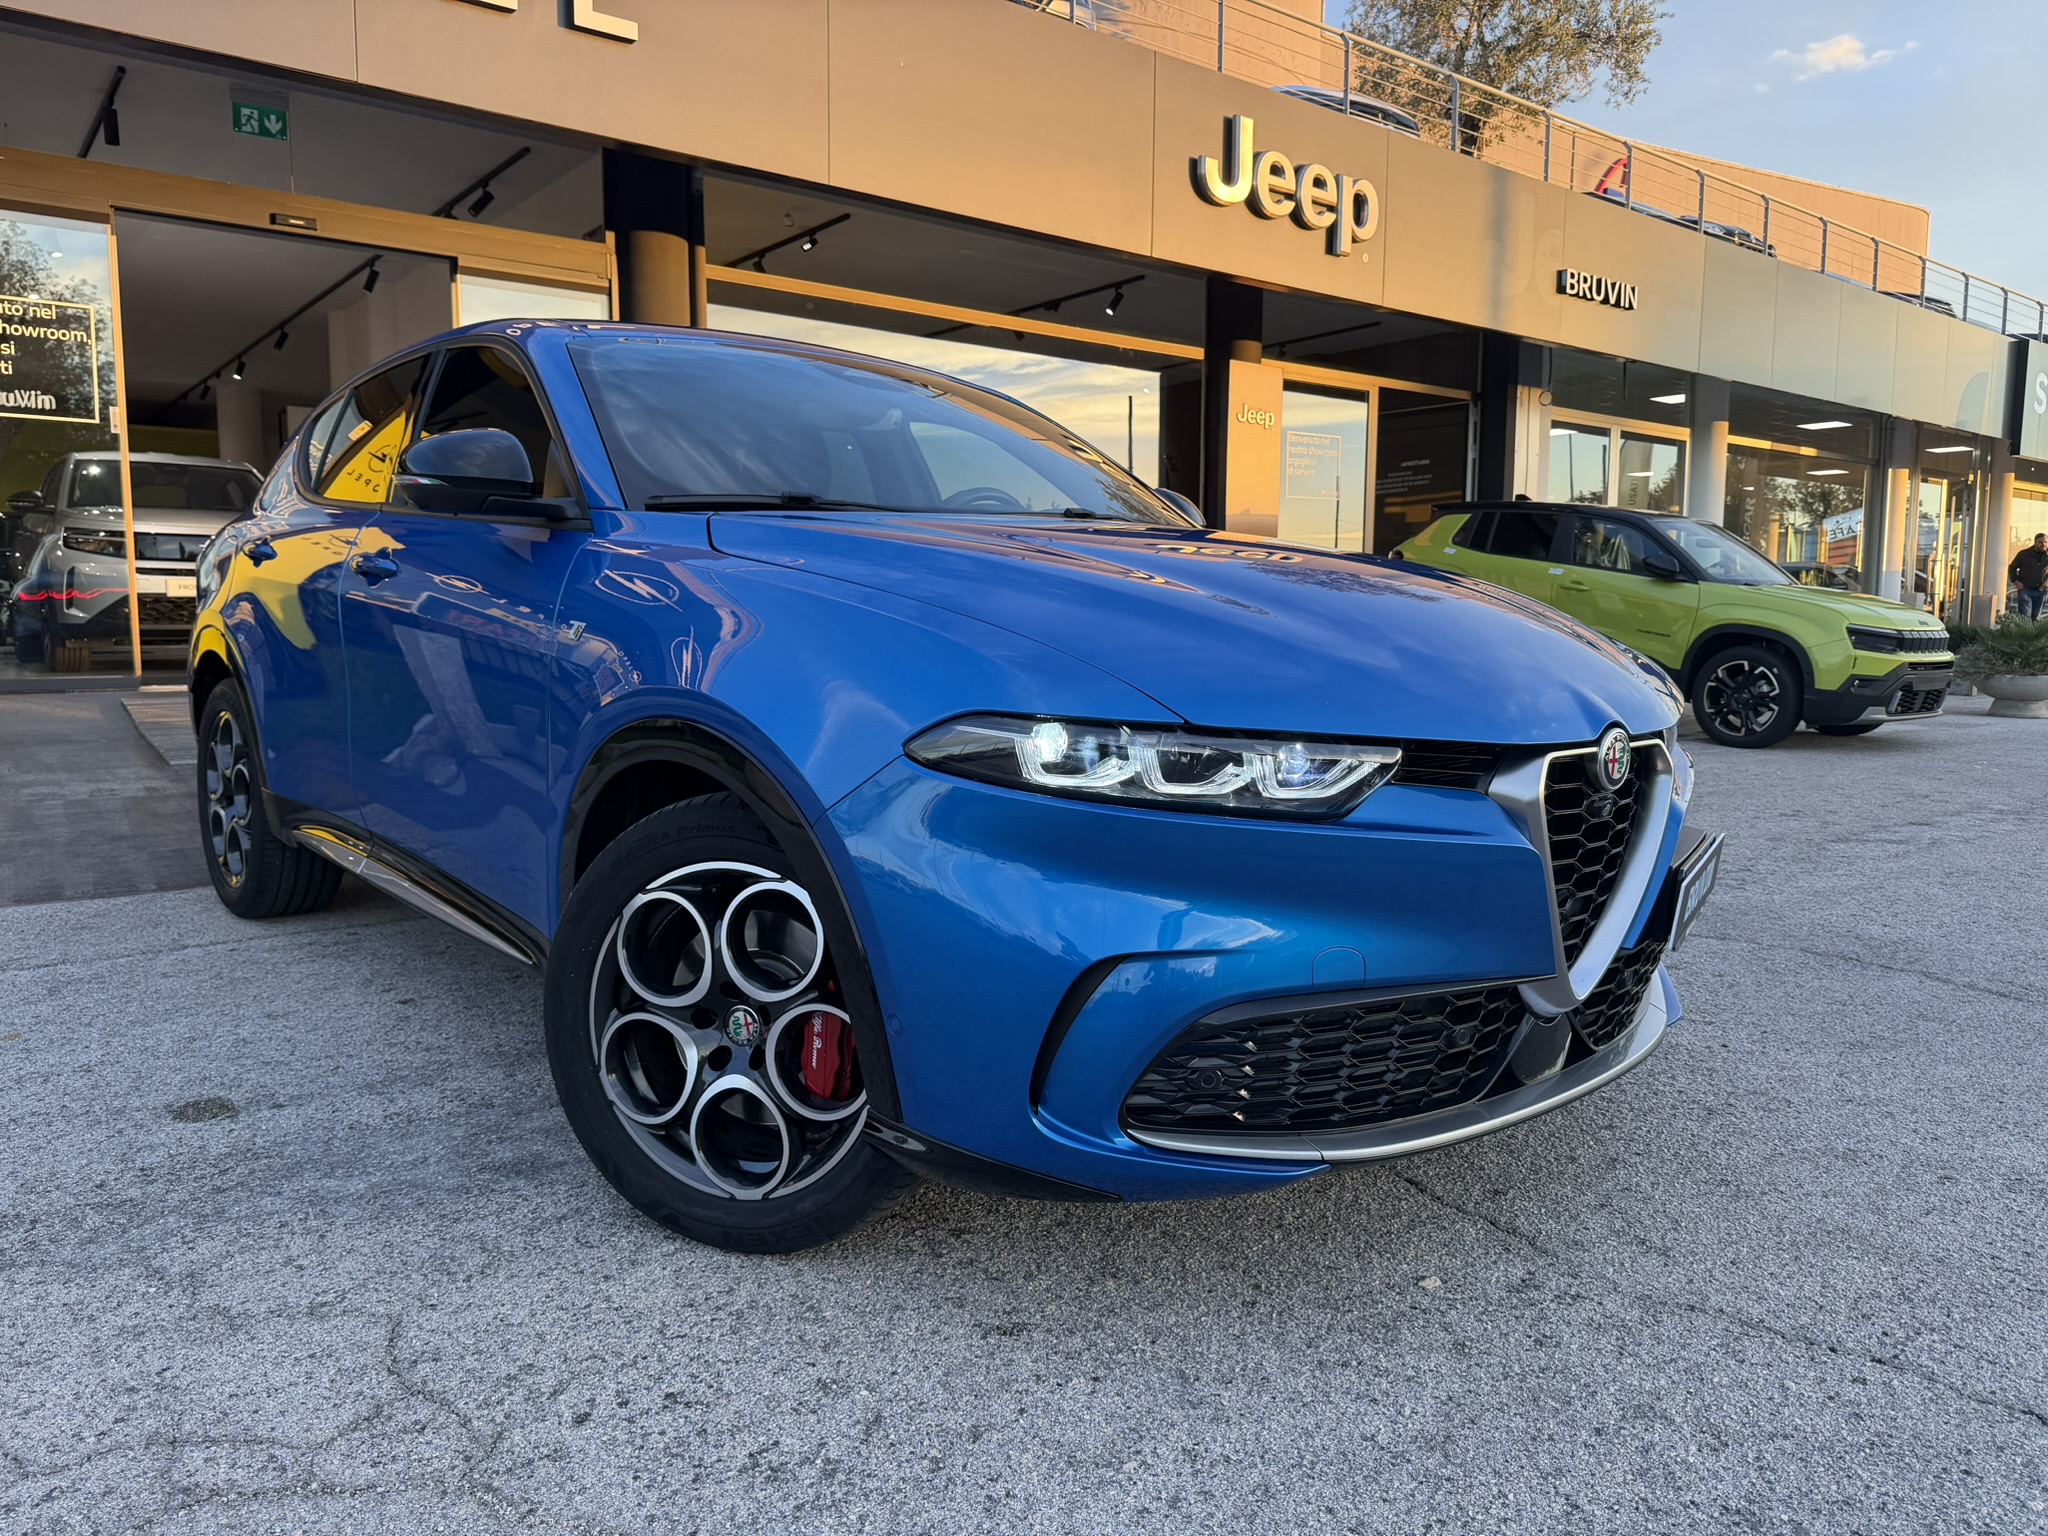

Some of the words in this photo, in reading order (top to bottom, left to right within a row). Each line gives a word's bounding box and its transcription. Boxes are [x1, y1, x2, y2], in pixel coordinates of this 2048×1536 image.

[1196, 113, 1379, 257] Jeep
[1564, 267, 1639, 311] BRUVIN
[29, 304, 57, 320] nel
[1236, 403, 1275, 430] Jeep
